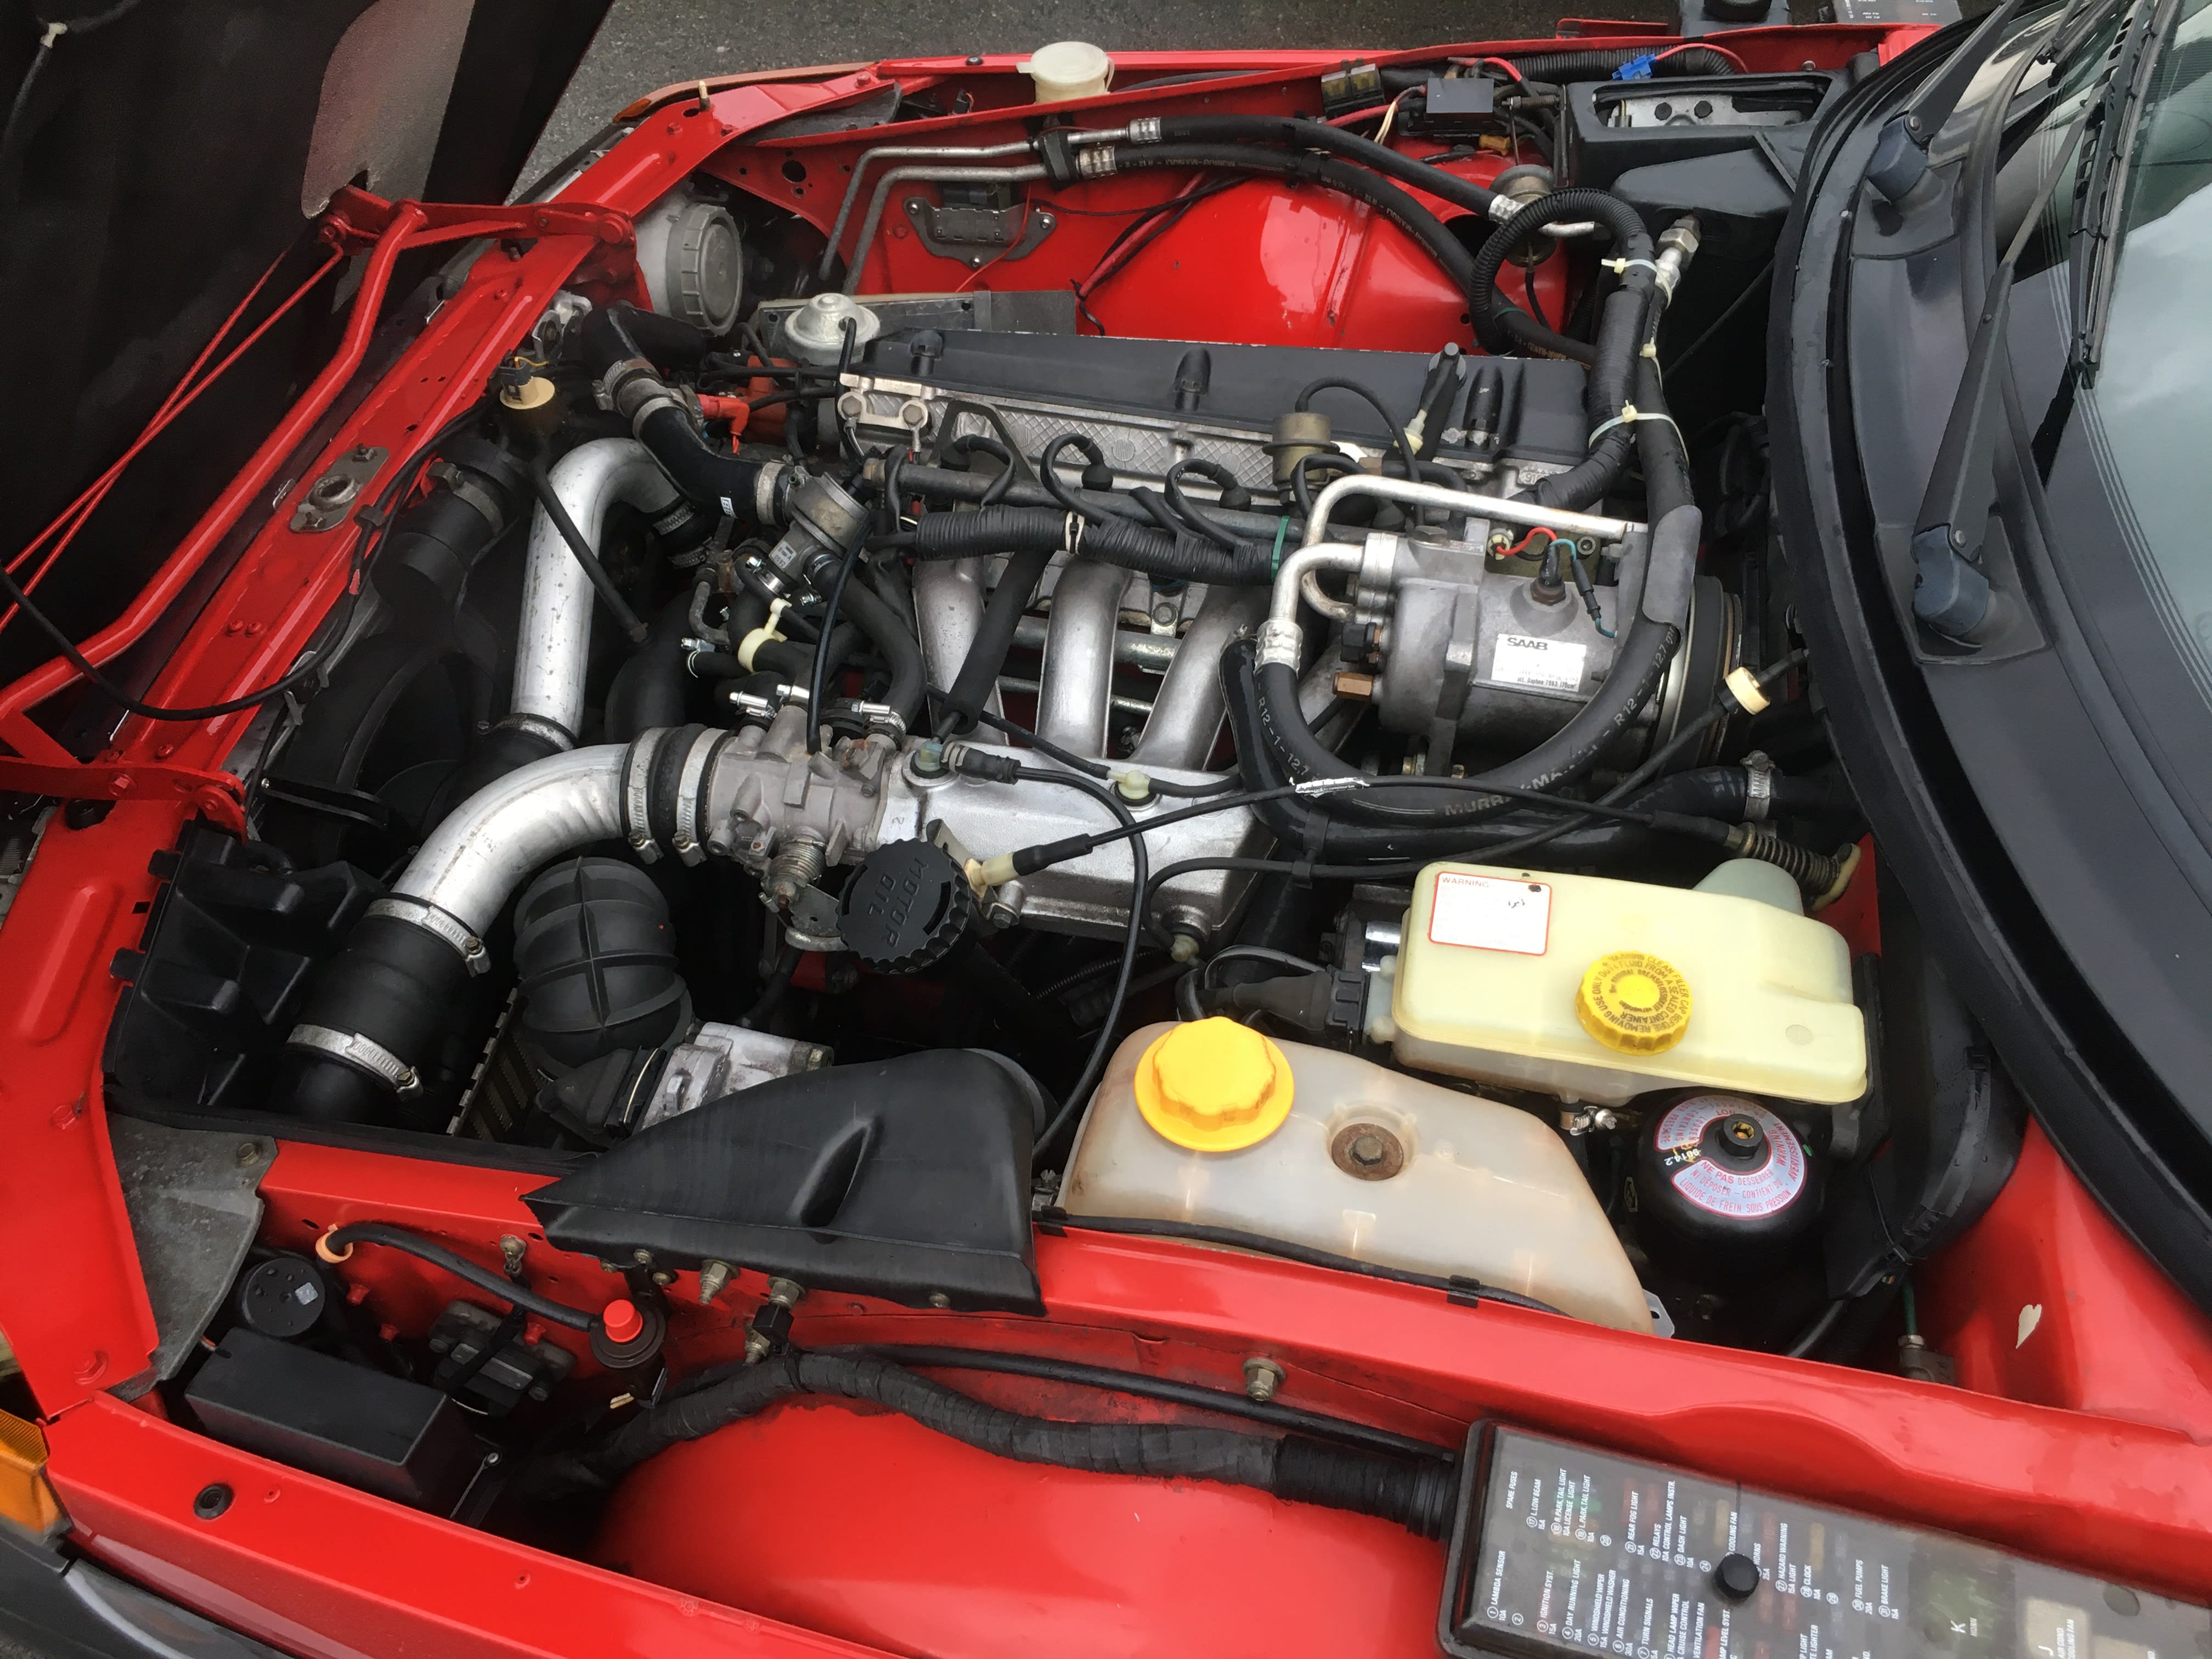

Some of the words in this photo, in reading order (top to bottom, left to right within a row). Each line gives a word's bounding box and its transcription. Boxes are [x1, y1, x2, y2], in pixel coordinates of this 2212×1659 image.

[1507, 637, 1548, 651] SAAB
[1442, 877, 1489, 888] WARNING
[868, 872, 896, 915] OIL
[885, 857, 929, 947] MOTOR
[1645, 963, 1667, 978] FROM
[1647, 956, 1674, 974] CLEAN
[1592, 976, 1602, 995] ONLY
[1672, 974, 1689, 998] FILLER
[1593, 995, 1608, 1011] USE
[1666, 986, 1679, 1013] SEALED
[1679, 999, 1689, 1014] CAP
[1604, 1011, 1651, 1032] REMOVING
[1620, 1011, 1669, 1024] CONTAINER
[1655, 1013, 1683, 1031] BEFORE
[1660, 1113, 1679, 1143] PRESSURE
[1675, 1110, 1697, 1142] CONTAINS
[1689, 1116, 1707, 1141] LOOSEN
[1768, 1130, 1786, 1166] WARNING
[1773, 1122, 1801, 1182] AVERTISSEMENT
[1701, 1161, 1716, 1175] NE
[1715, 1171, 1734, 1184] PAS
[1738, 1169, 1774, 1186] DESSERRER
[1691, 1170, 1701, 1179] NI
[1742, 1184, 1773, 1199] CONTIENT
[1775, 1179, 1783, 1189] DU
[1680, 1178, 1706, 1200] LIQUIDE
[1706, 1195, 1717, 1206] DE
[1719, 1200, 1742, 1213] FREIN
[1747, 1203, 1763, 1213] SOUS
[1766, 1188, 1792, 1209] PRESSION
[1509, 1471, 1518, 1489] FUSES
[1559, 1468, 1567, 1486] LIGHT
[1582, 1475, 1591, 1492] LIGHT
[1506, 1490, 1515, 1509] SPARE
[1567, 1480, 1576, 1499] LIGHT
[1667, 1480, 1676, 1499] INSTR.
[1564, 1500, 1573, 1525] LICENSE
[1665, 1500, 1674, 1521] LAMPS
[1627, 1523, 1636, 1541] REAR
[1652, 1523, 1661, 1547] RELAYS
[1662, 1521, 1672, 1550] CONTROL
[1729, 1525, 1737, 1551] COOLING
[1779, 1522, 1788, 1553] WARNING
[1677, 1535, 1685, 1553] DASH
[1496, 1550, 1506, 1576] SENSOR
[1572, 1559, 1581, 1579] LIGHT
[1778, 1553, 1786, 1579] HAZARD
[1855, 1559, 1864, 1582] PUMPS
[1545, 1570, 1554, 1588] SYST.
[1606, 1569, 1616, 1595] WASHER
[1491, 1578, 1502, 1605] LAMBDA
[1567, 1579, 1579, 1611] RUNNING
[1617, 1578, 1630, 1626] CONDITIONING
[1813, 1589, 1821, 1600] 10A
[1881, 1583, 1889, 1605] BRAKE
[1540, 1588, 1551, 1618] IGNITION
[1590, 1593, 1602, 1632] WINDSHIELD
[1596, 1573, 1605, 1593] WIPER
[1644, 1598, 1654, 1626] SIGNALS
[1671, 1593, 1680, 1614] WIPER
[1865, 1602, 1873, 1615] 20A
[1565, 1612, 1574, 1626] DAY
[1601, 1595, 1613, 1634] WINDSHIELD
[1669, 1615, 1678, 1634] LAMP
[1680, 1600, 1690, 1630] CONTROL
[1722, 1609, 1731, 1627] SYST.
[1548, 1623, 1557, 1635] 15A
[1574, 1629, 1582, 1642] 20A
[1616, 1626, 1624, 1639] AIR
[1641, 1627, 1650, 1645] TURN
[1693, 1615, 1704, 1658] VENTILATION
[1720, 1628, 1729, 1646] LEVEL
[1951, 1620, 1966, 1633] K
[1600, 1637, 1608, 1648] 15A
[1667, 1634, 1676, 1652] HEAD
[1677, 1630, 1687, 1655] CRUISE
[1800, 1633, 1808, 1654] LIGHT
[1810, 1624, 1819, 1652] LIGHTER
[1625, 1643, 1633, 1656] 30A
[2038, 1645, 2054, 1656] J
